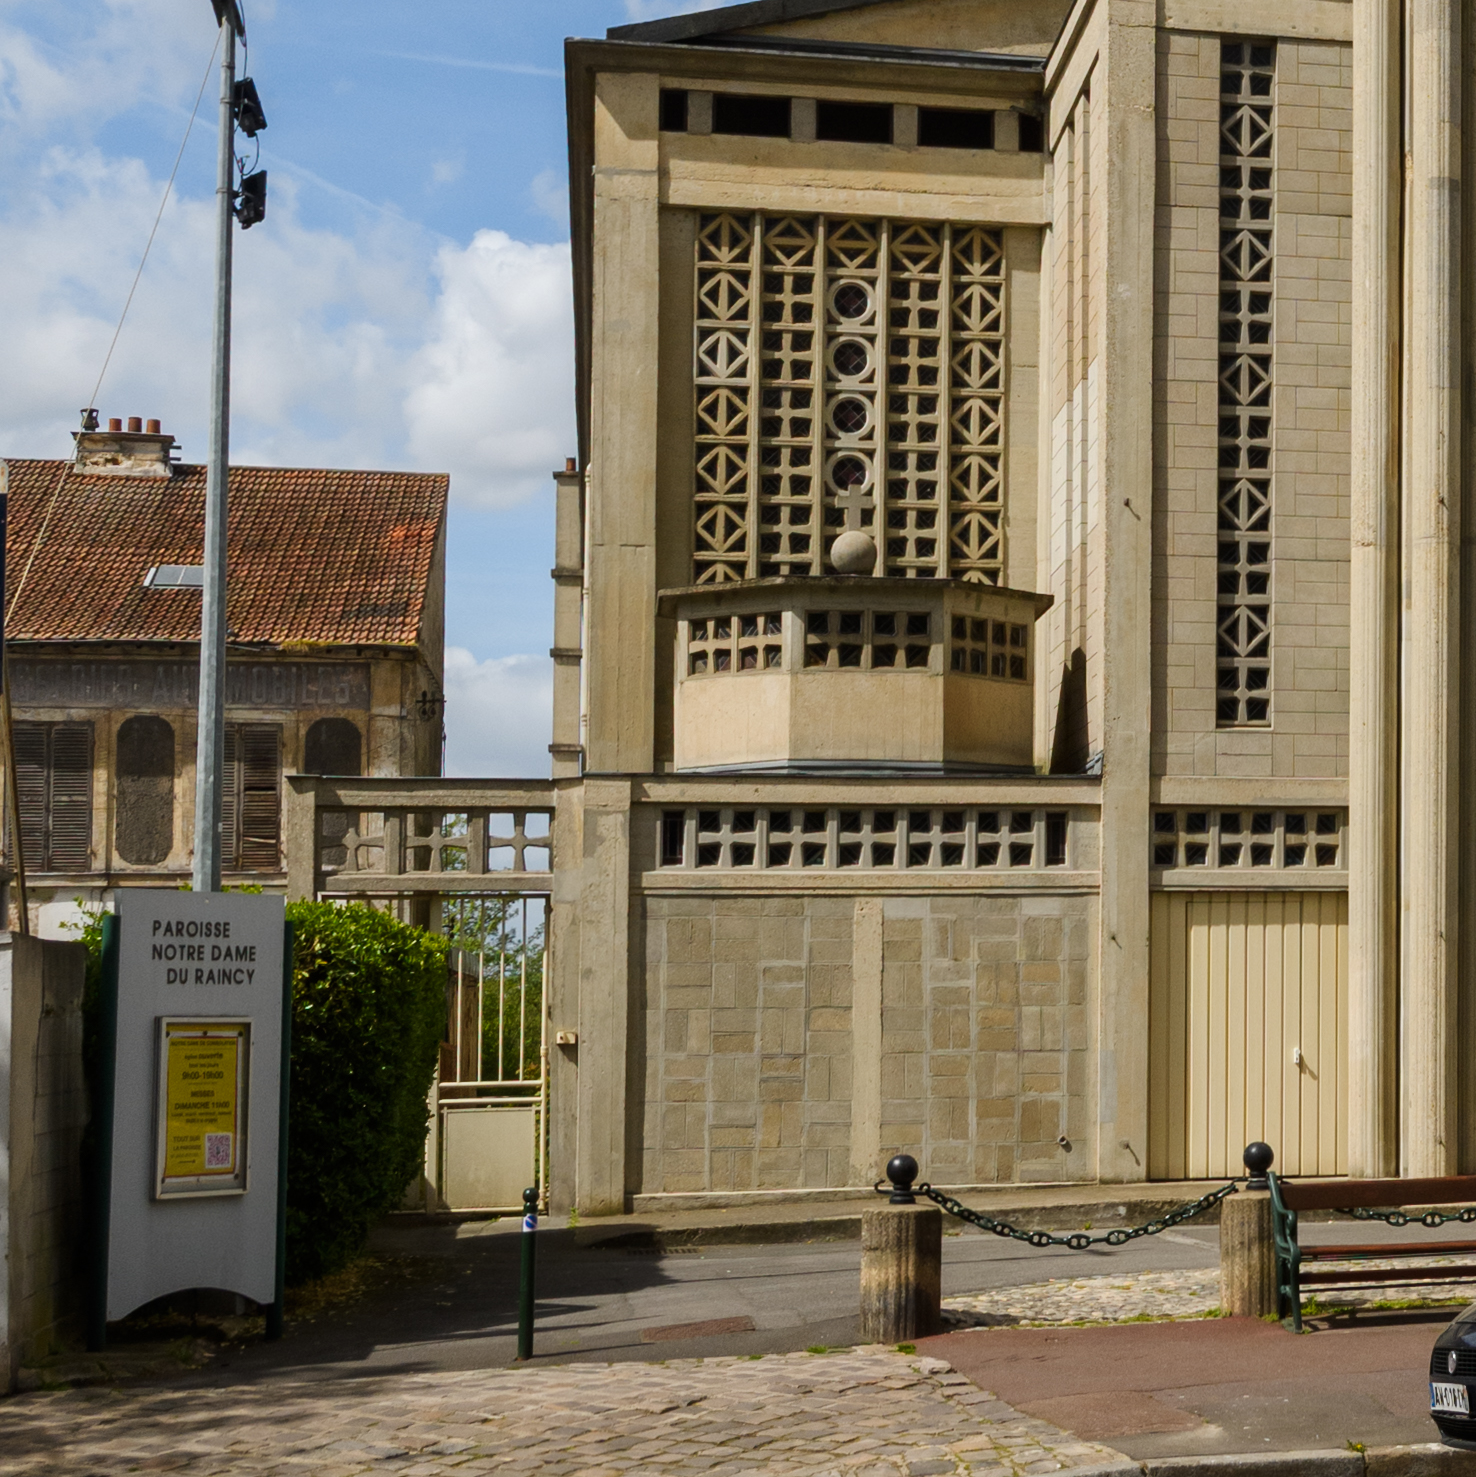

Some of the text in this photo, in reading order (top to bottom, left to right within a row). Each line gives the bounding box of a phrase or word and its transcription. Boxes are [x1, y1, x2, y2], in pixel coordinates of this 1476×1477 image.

[152, 665, 349, 705] AUMOBILES
[152, 920, 230, 938] PAROISSE
[152, 944, 256, 962] NOTRE DAME
[167, 968, 255, 985] DU RAINCY
[174, 1101, 210, 1110] DIMANCHE
